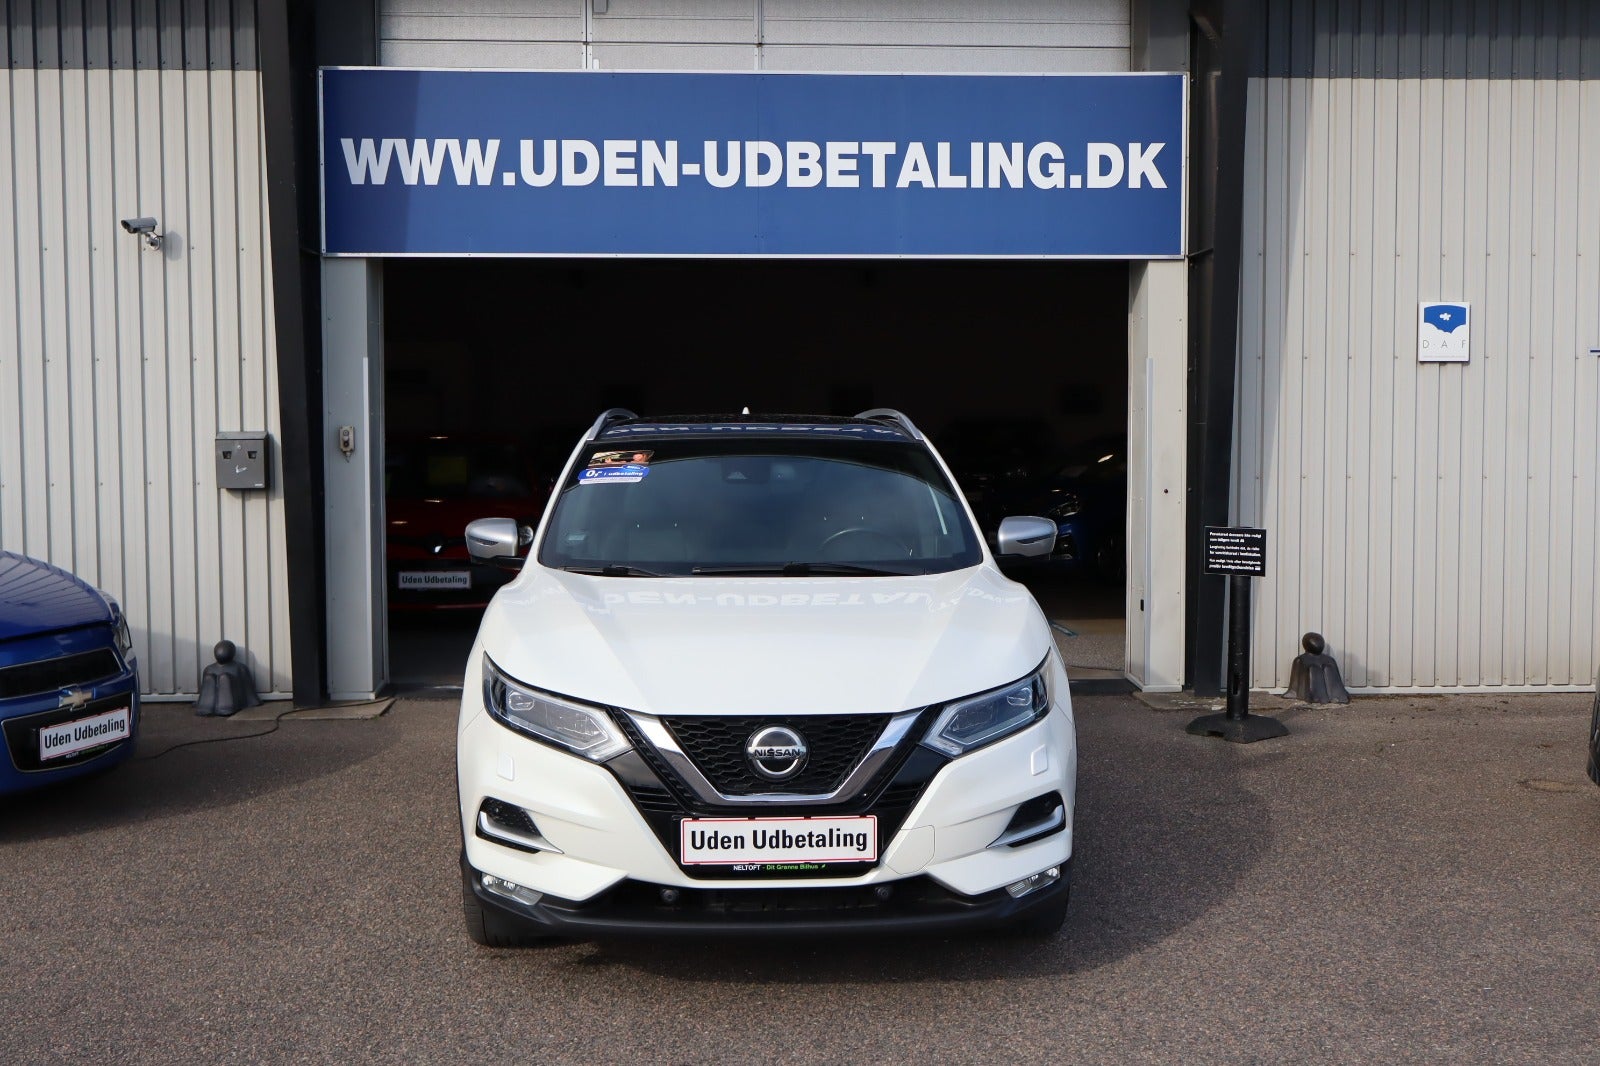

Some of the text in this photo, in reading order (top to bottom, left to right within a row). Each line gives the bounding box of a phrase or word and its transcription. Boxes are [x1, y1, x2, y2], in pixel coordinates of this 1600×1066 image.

[340, 138, 1168, 190] WWW.UDEN-UDBETALING.DK
[401, 575, 468, 585] Uden Udbetaling
[44, 732, 72, 749] Uden
[74, 718, 126, 742] Udbetaling
[754, 747, 801, 757] NISSAN
[691, 828, 868, 852] Uden Udbetaling
